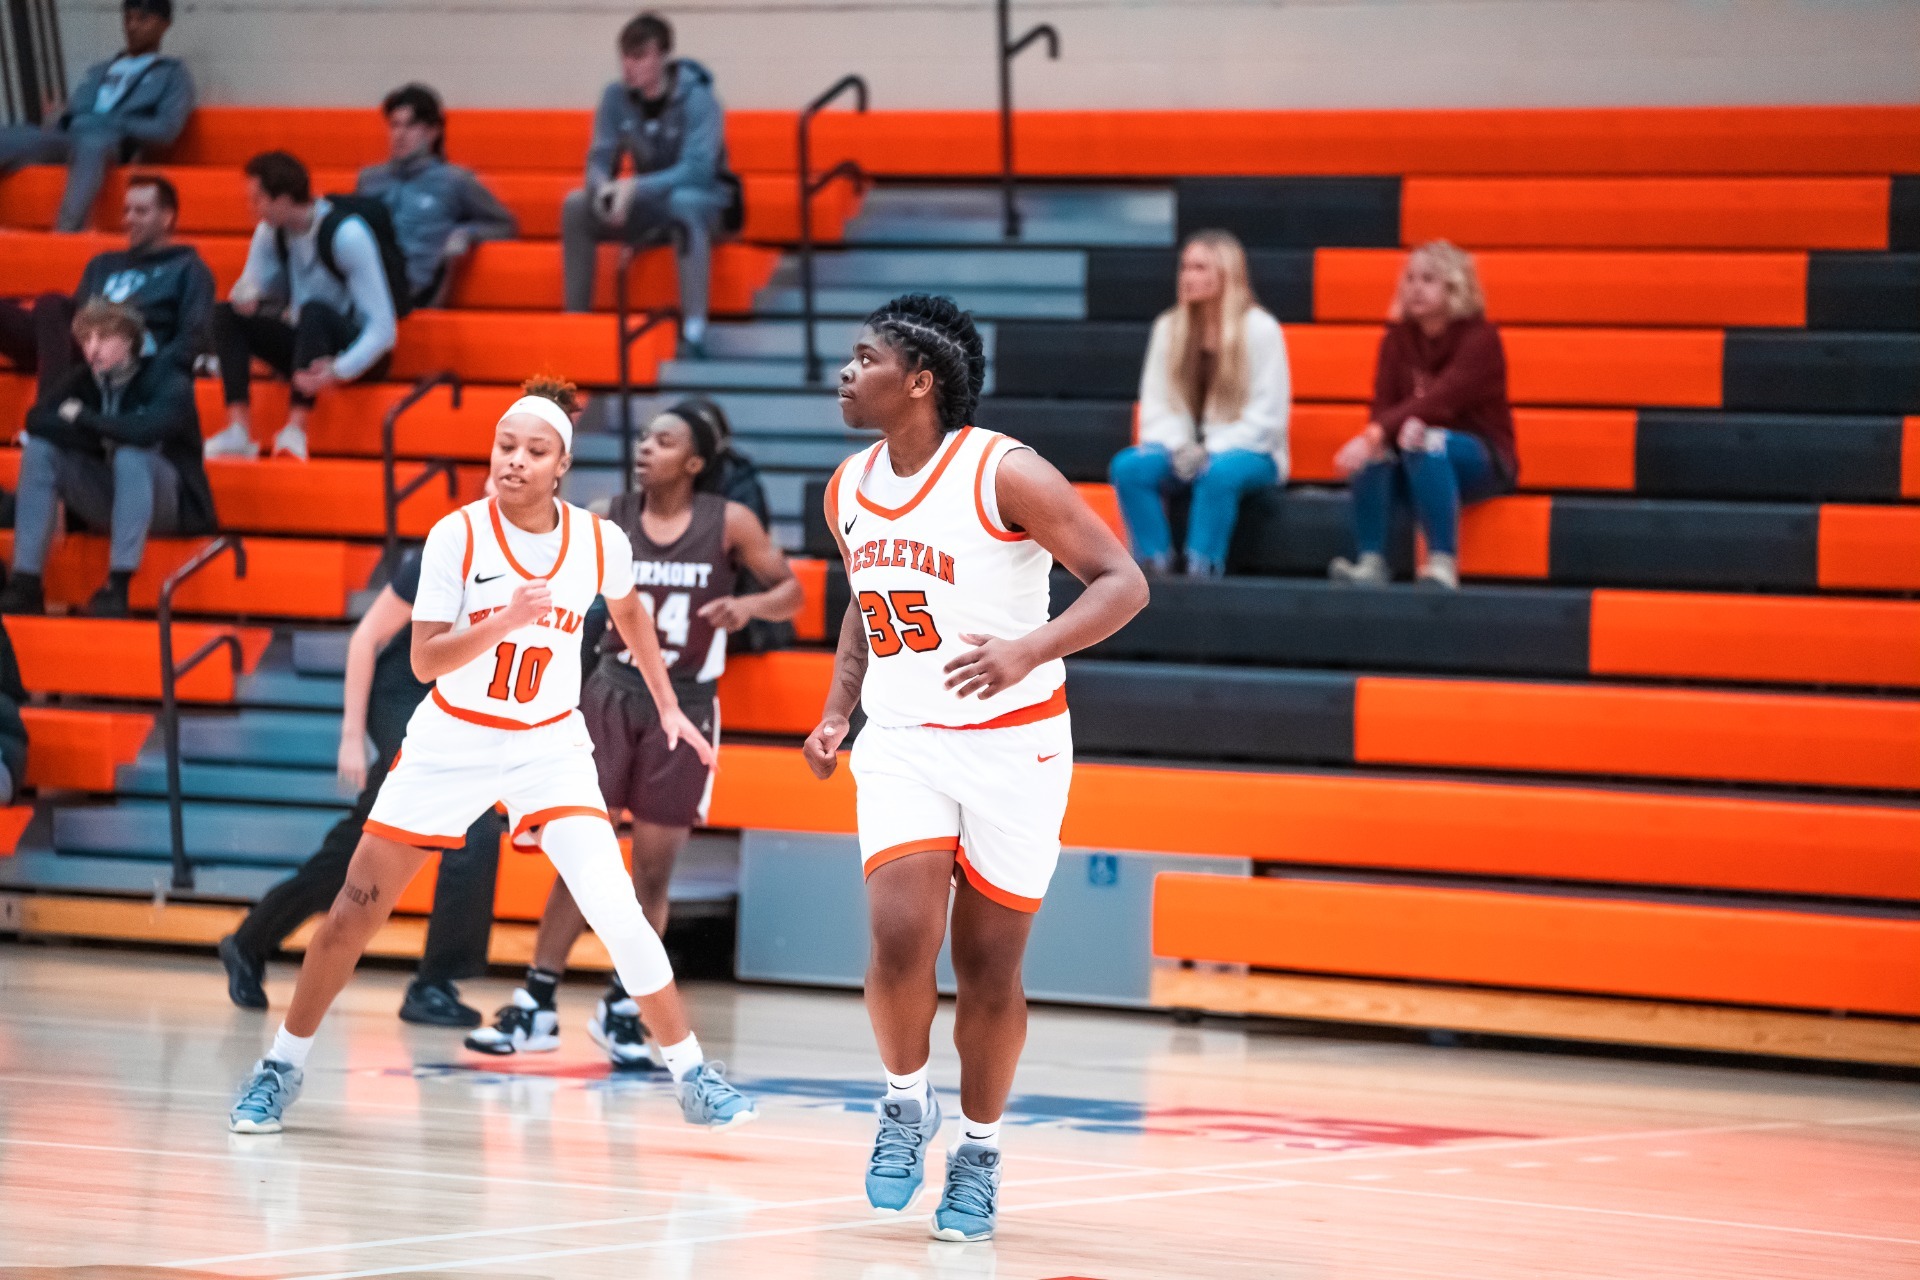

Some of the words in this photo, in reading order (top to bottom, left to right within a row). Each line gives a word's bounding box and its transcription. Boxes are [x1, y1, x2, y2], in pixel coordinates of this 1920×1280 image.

[633, 560, 713, 588] RMONT
[849, 538, 955, 586] ESLEYAN
[858, 590, 943, 658] 35
[487, 641, 553, 704] 10
